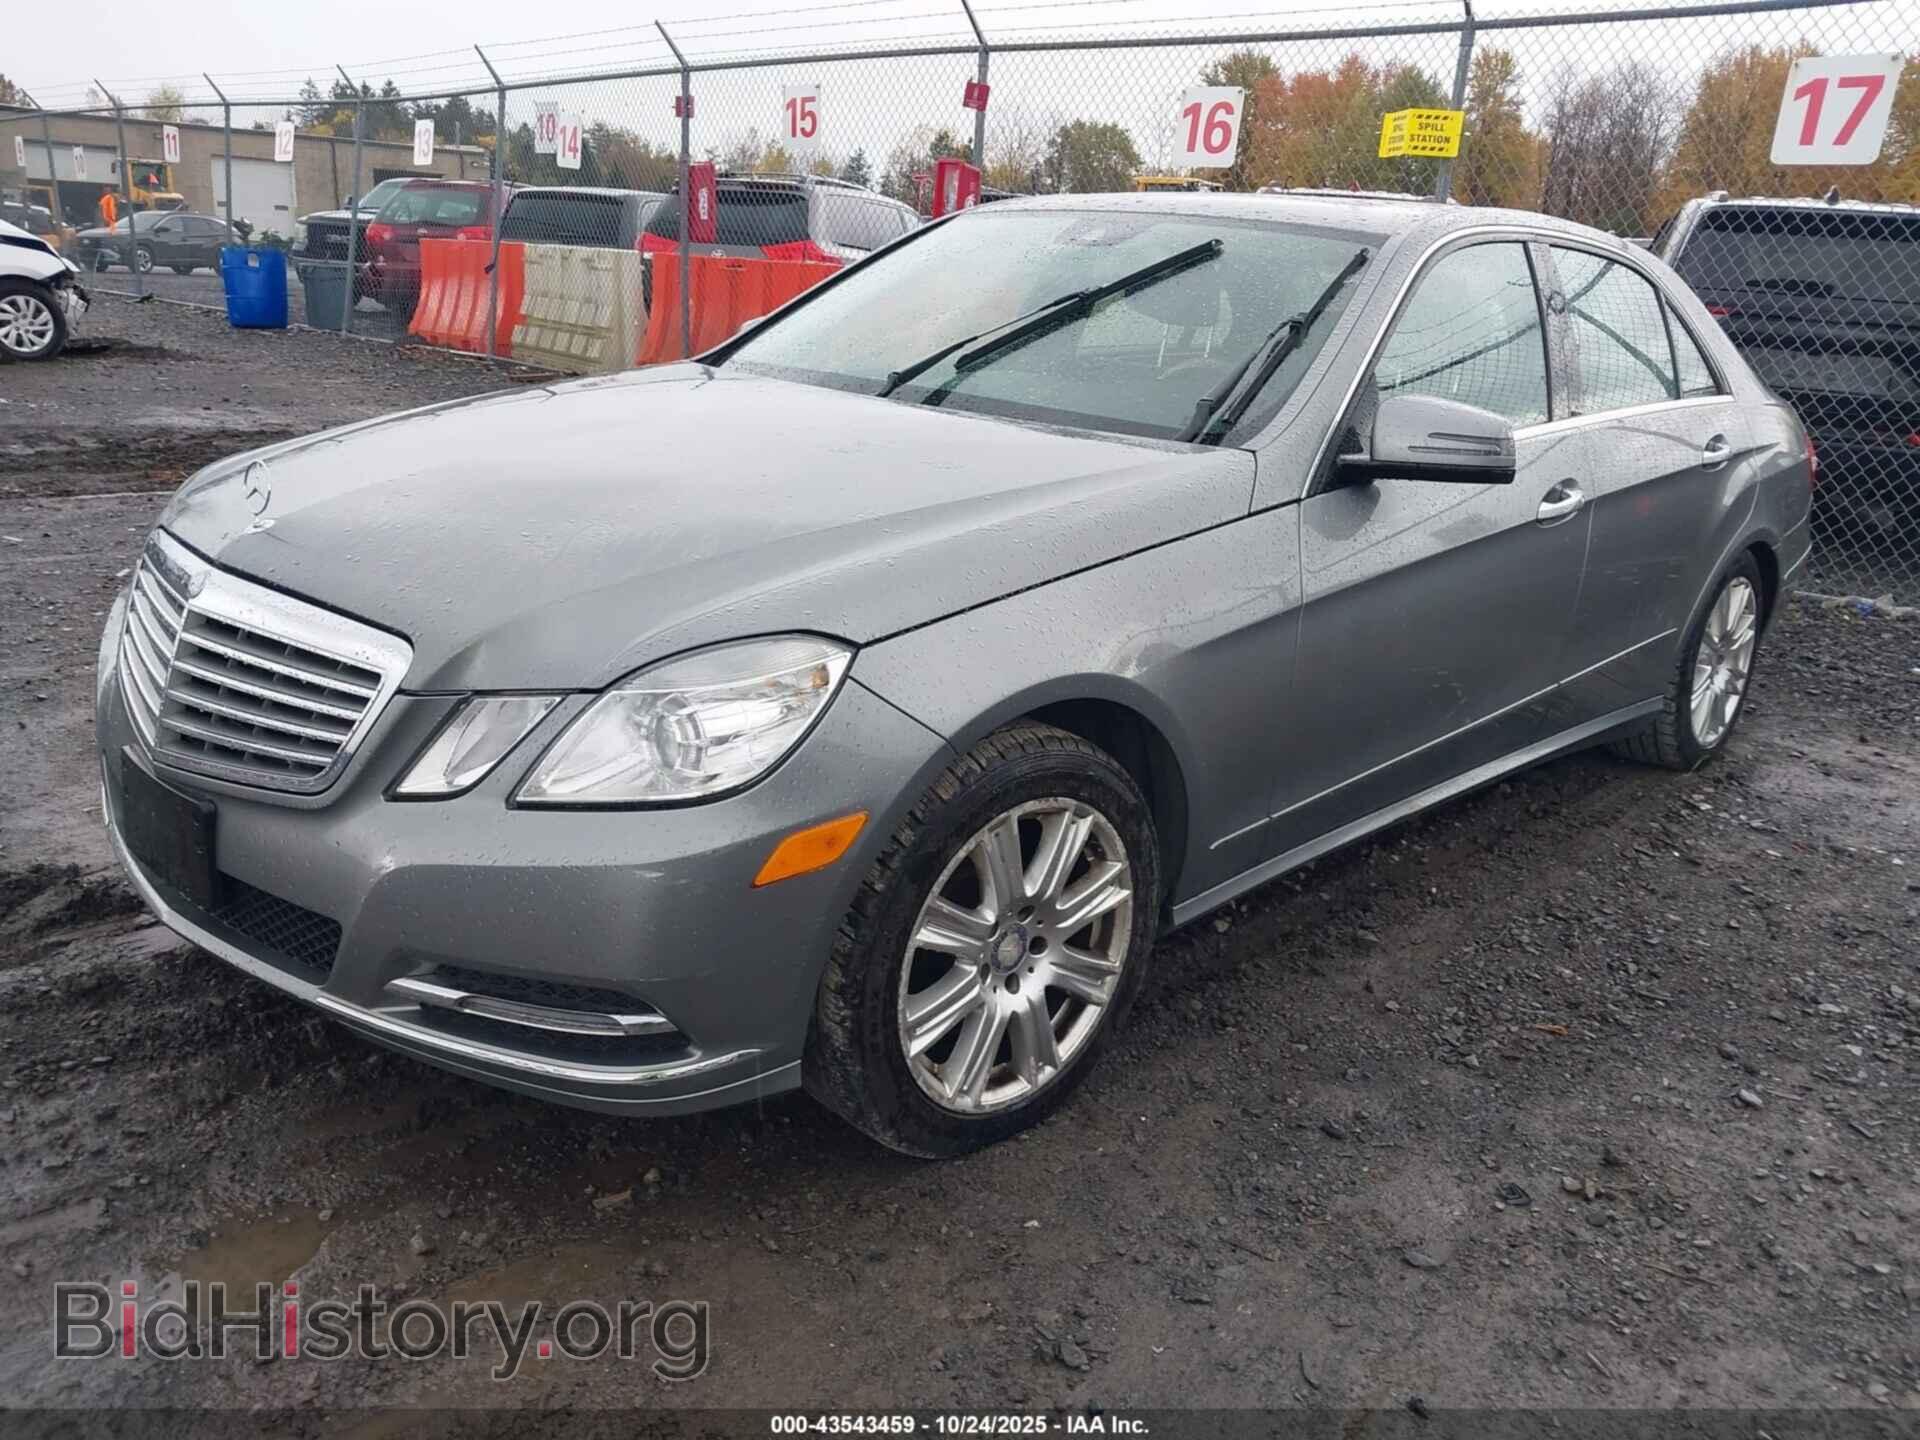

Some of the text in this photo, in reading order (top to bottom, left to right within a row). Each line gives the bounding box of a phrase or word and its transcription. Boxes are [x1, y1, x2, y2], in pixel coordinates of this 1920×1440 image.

[786, 96, 817, 138] 15
[1793, 75, 1886, 146] 17
[538, 112, 557, 142] 10
[1183, 101, 1234, 154] 16
[1408, 133, 1452, 144] STATION
[1417, 121, 1446, 132] SPILL
[165, 133, 177, 156] 11
[278, 129, 292, 155] 12
[416, 127, 432, 158] 13
[559, 125, 579, 160] 14
